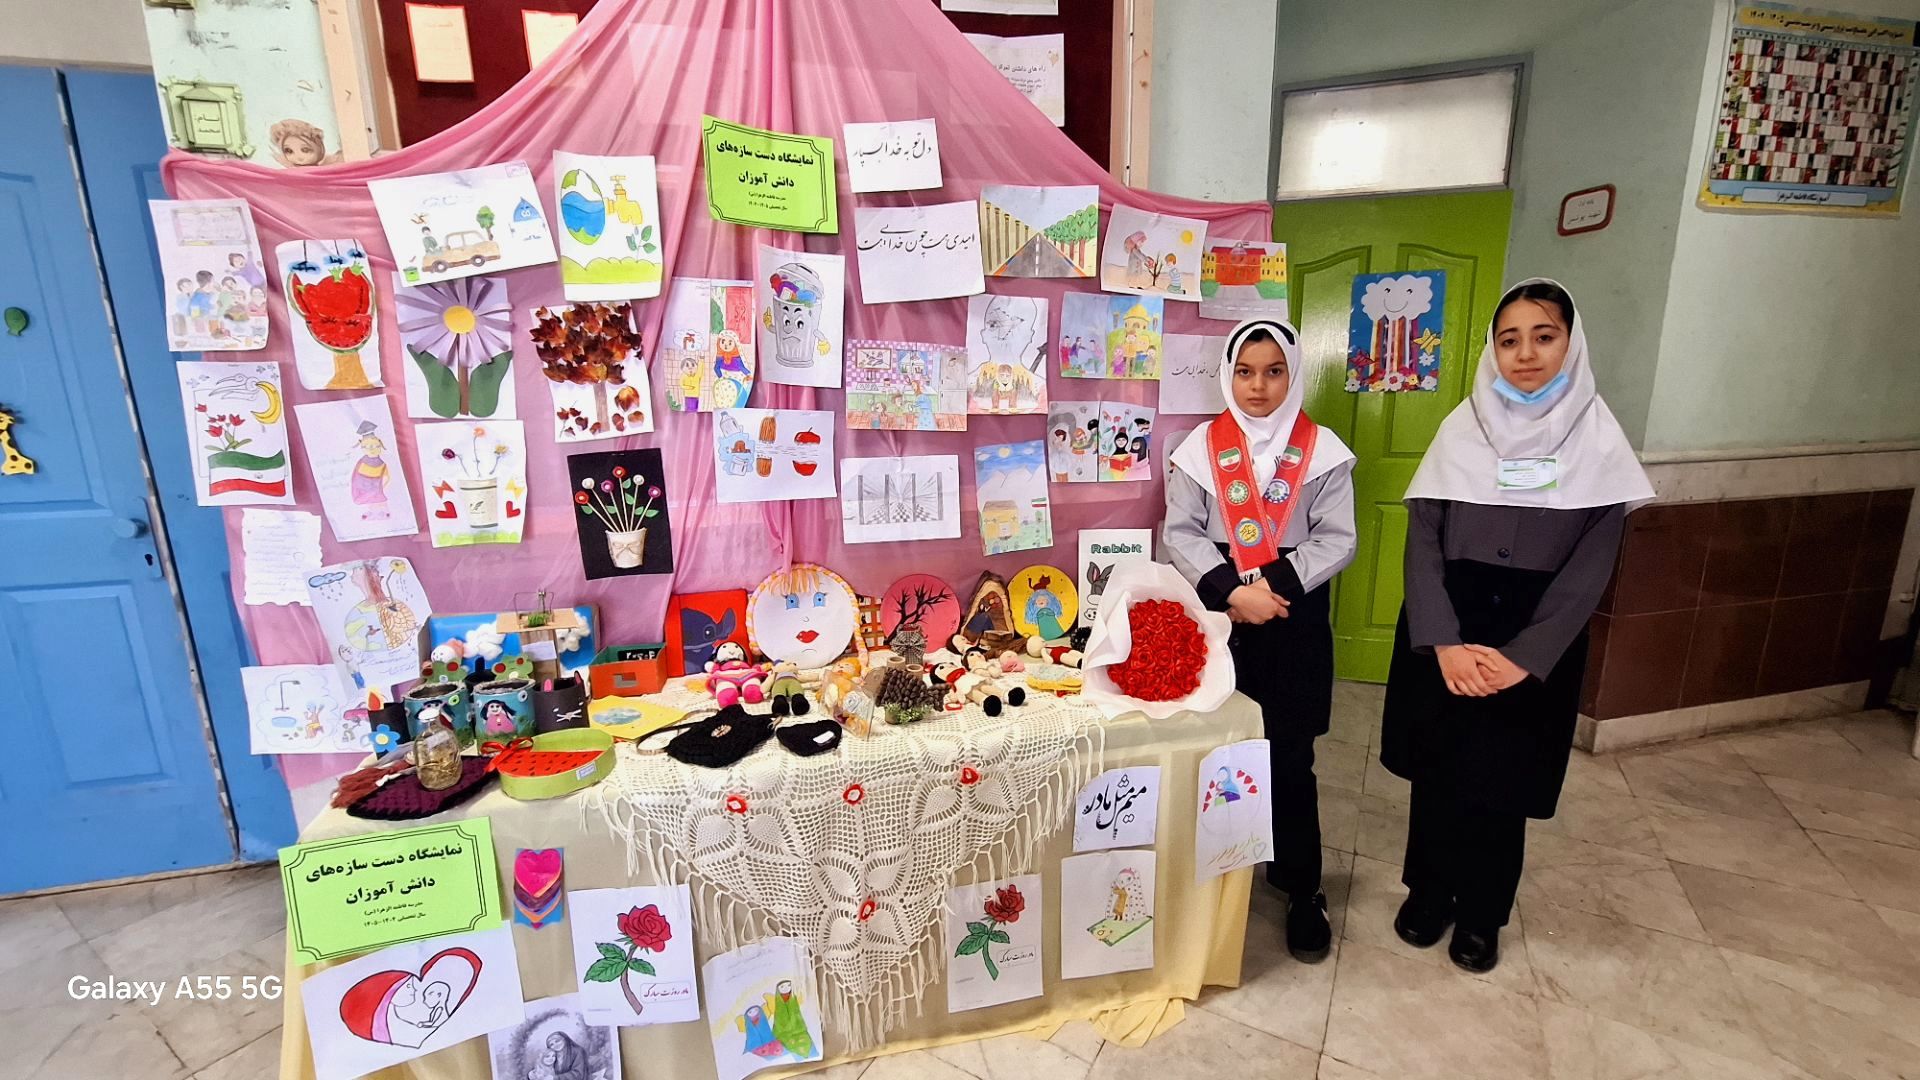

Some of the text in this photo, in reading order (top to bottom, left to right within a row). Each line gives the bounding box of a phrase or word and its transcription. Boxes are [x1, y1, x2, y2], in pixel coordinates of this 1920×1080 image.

[754, 150, 775, 161] دست
[778, 152, 814, 166] نمایشگاه
[739, 170, 794, 188] دانش آموزان
[1091, 544, 1143, 554] Rabbit
[1082, 781, 1112, 815] مادر
[409, 843, 463, 862] نمایشگاه
[372, 854, 404, 868] دست
[346, 876, 436, 904] دانش آموزان
